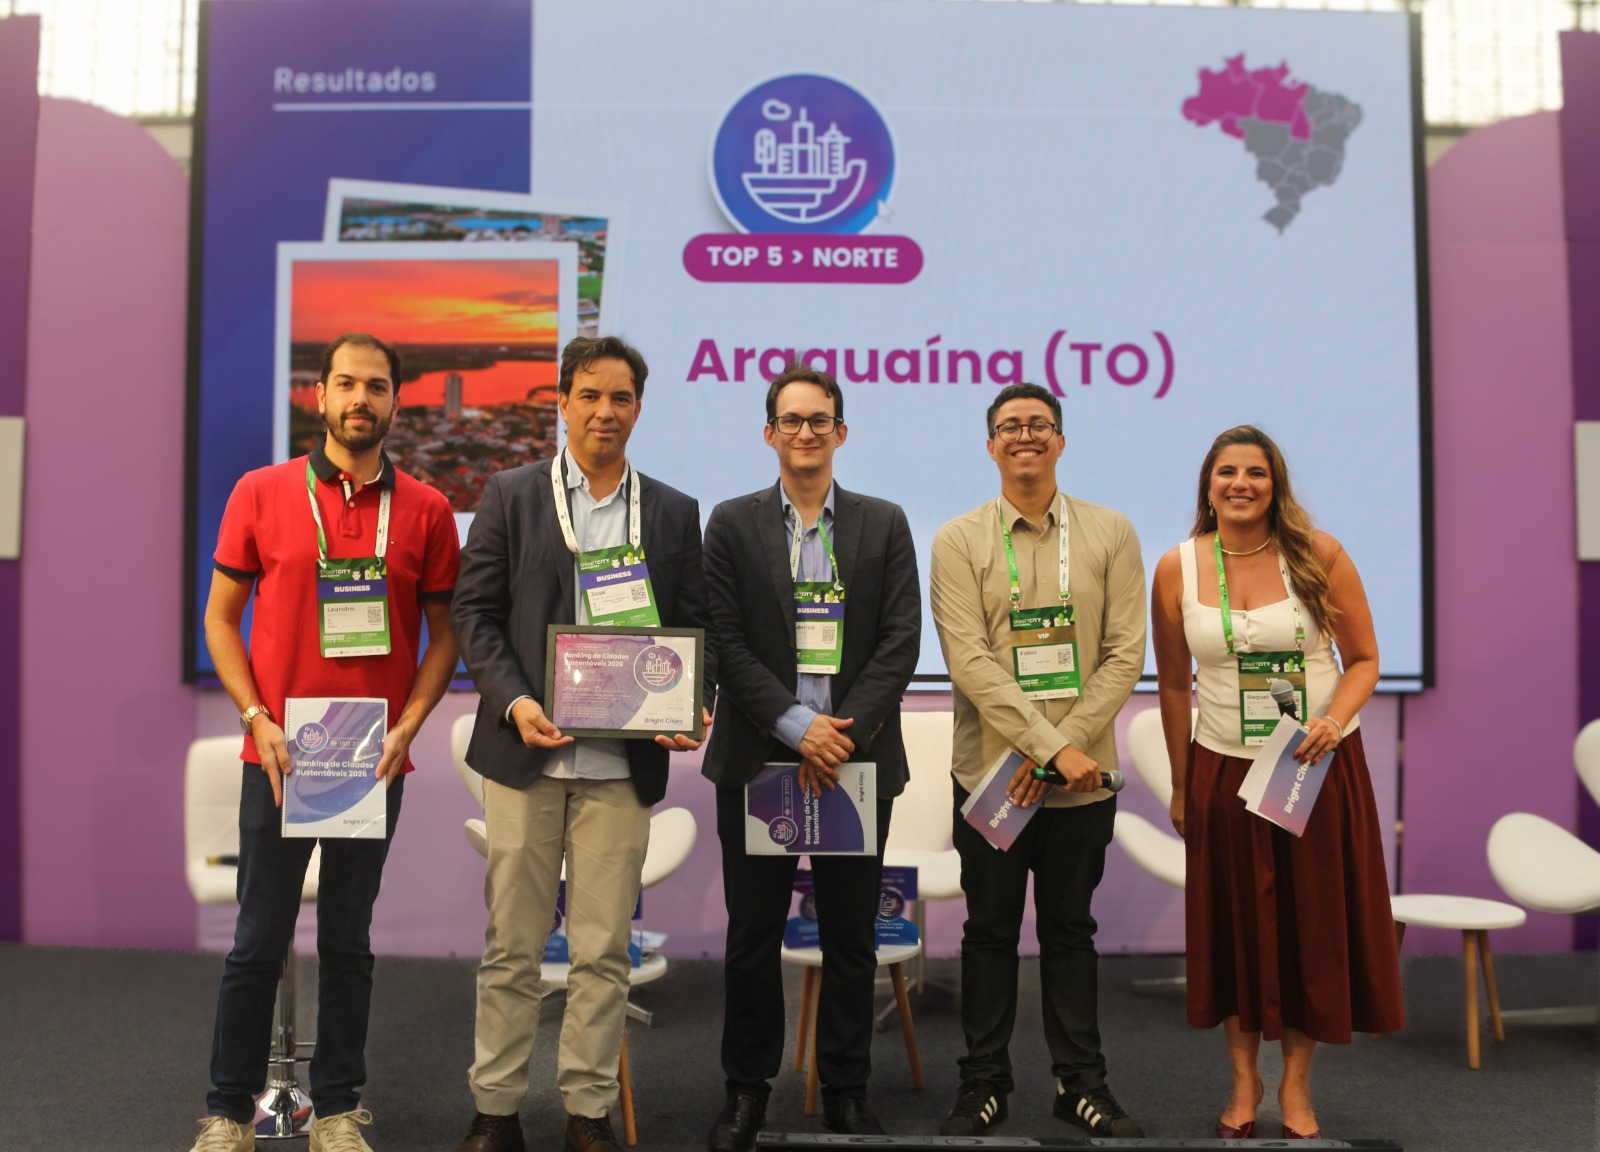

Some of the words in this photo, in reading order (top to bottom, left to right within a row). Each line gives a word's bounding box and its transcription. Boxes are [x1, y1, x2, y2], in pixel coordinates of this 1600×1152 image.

[273, 67, 437, 93] Resultados
[706, 246, 759, 267] TOP
[767, 246, 783, 267] 5
[813, 247, 899, 268] NORTE
[1045, 329, 1175, 399] (TO)
[596, 570, 632, 582] BUSINESS
[334, 585, 371, 593] BUSINESS
[1246, 694, 1269, 702] Raquel
[644, 717, 664, 725] Bright
[296, 760, 330, 769] Ranking
[341, 761, 374, 769] Cidades
[1283, 781, 1301, 814] Bright
[804, 805, 810, 814] de
[989, 800, 1012, 828] Bright
[804, 816, 812, 844] Ranking
